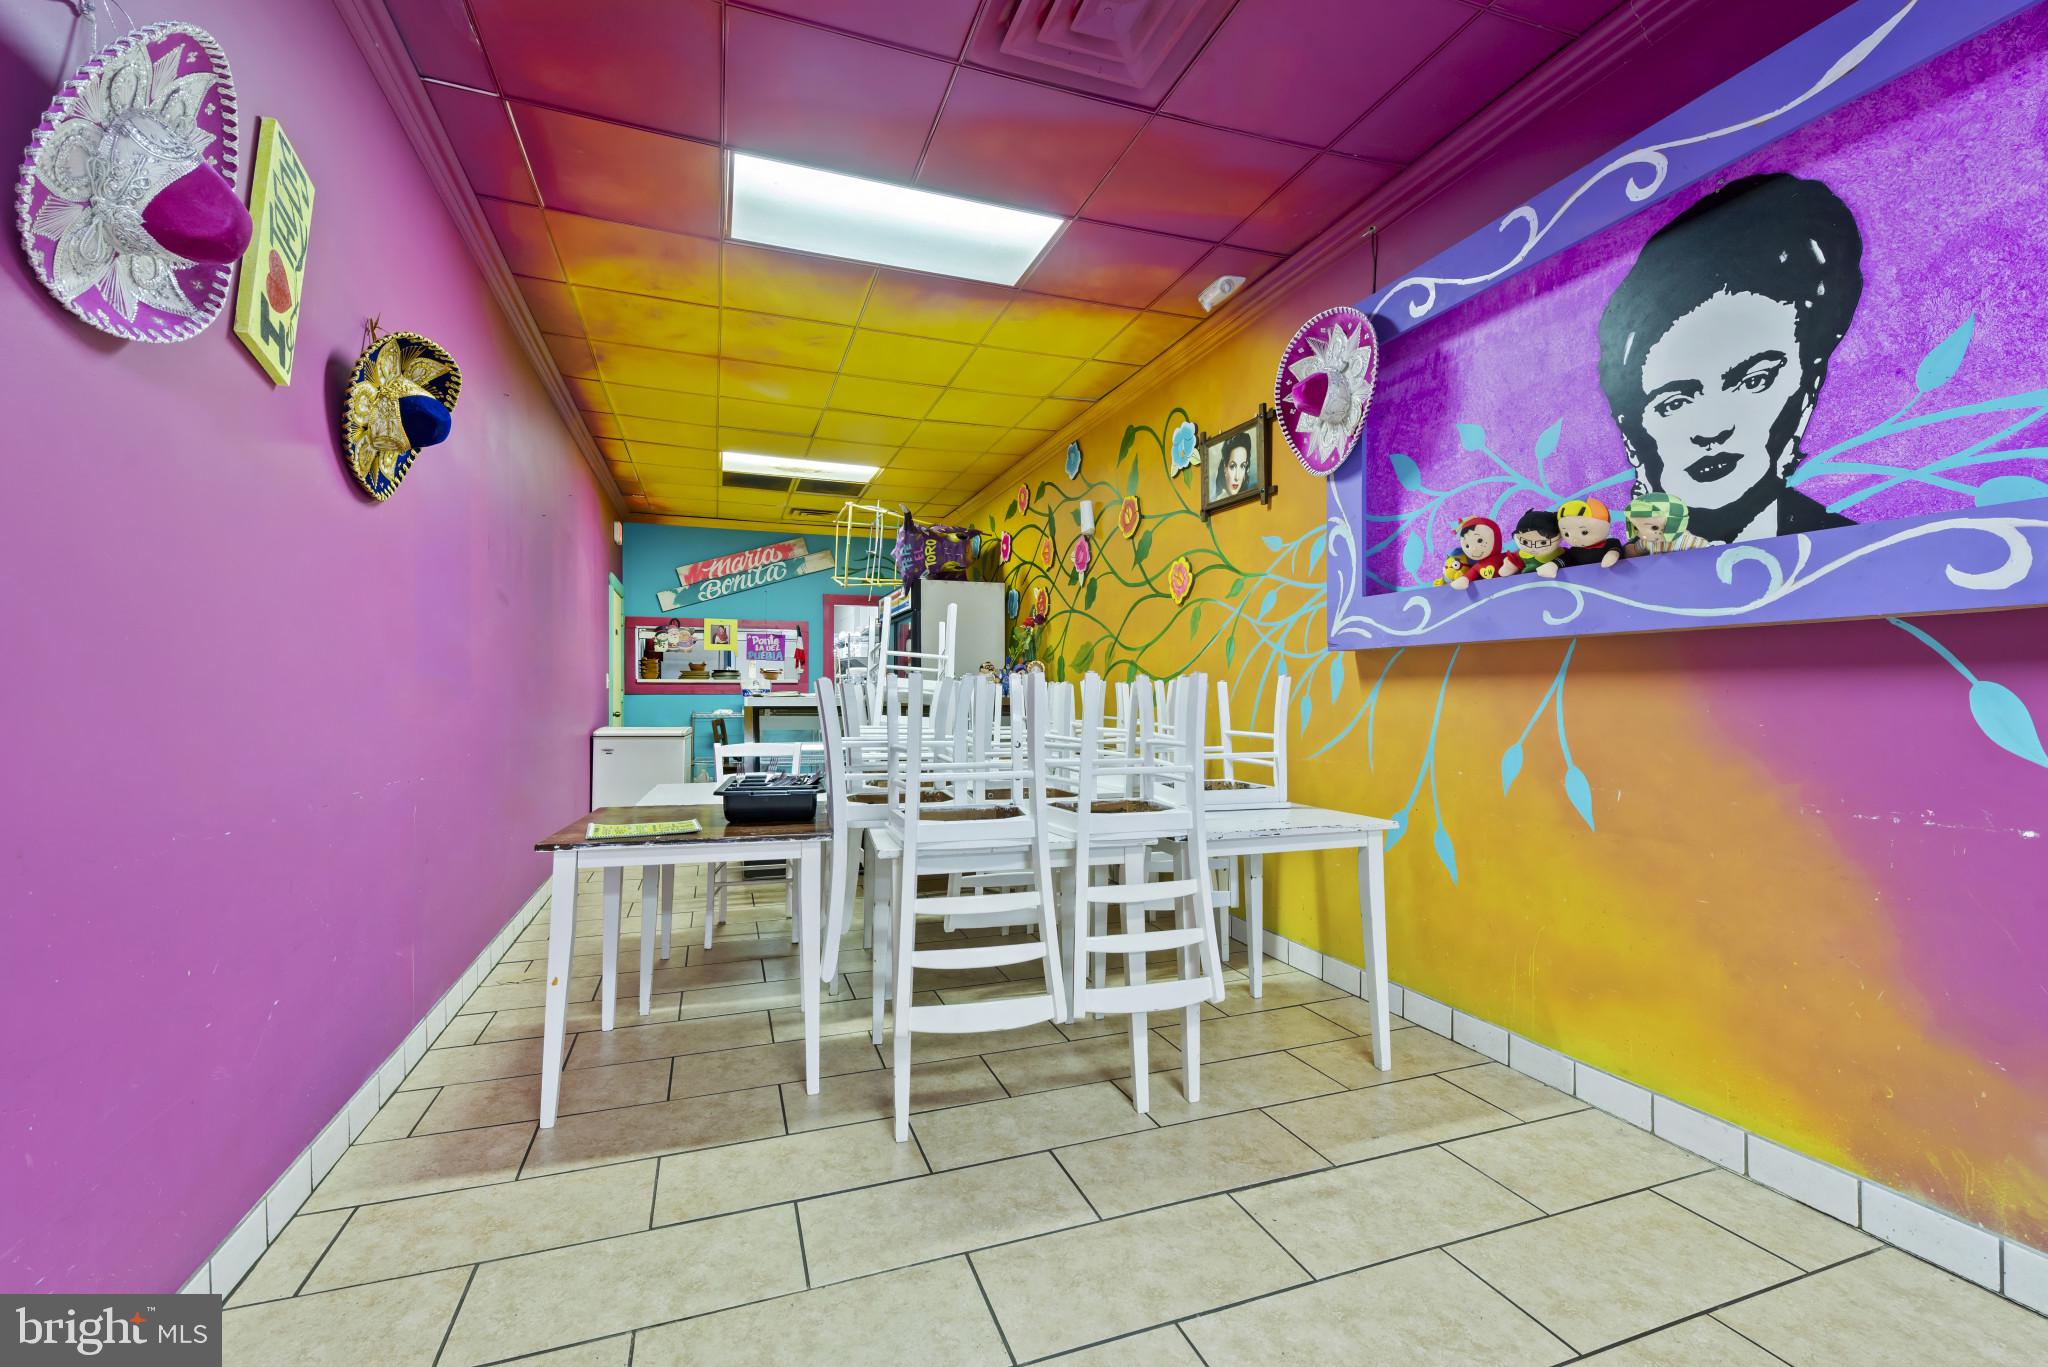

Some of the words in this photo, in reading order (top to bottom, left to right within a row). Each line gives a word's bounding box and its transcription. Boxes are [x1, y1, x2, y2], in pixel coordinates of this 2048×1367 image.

[268, 129, 310, 271] TACOS
[260, 290, 286, 368] I
[901, 543, 912, 571] PEPE
[914, 547, 925, 561] EL
[925, 539, 937, 568] TORO
[698, 562, 787, 601] Bonita
